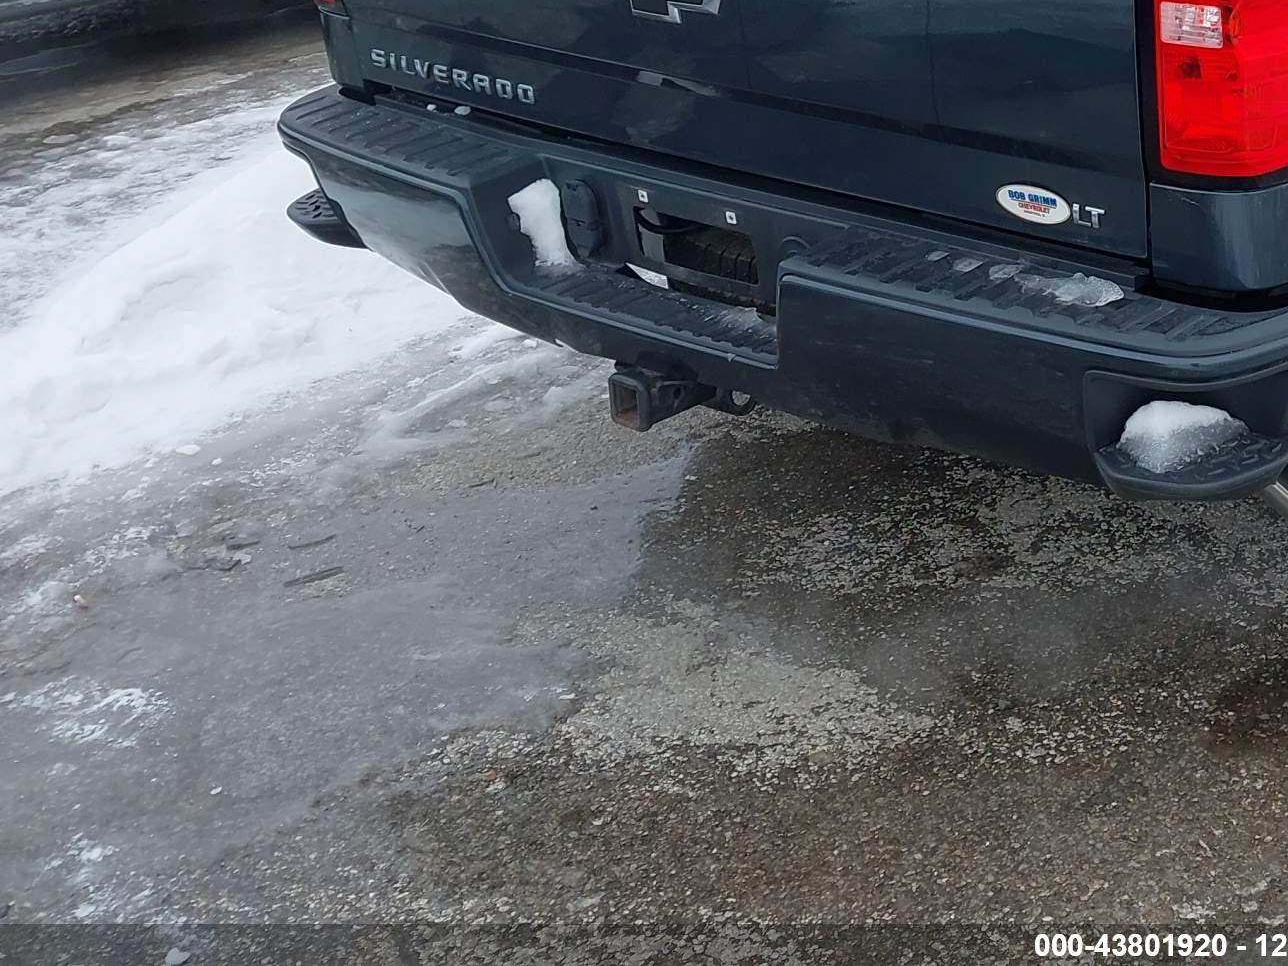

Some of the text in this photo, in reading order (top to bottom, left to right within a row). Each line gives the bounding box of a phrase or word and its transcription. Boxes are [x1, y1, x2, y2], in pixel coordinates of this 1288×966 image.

[370, 48, 536, 104] SILVERADO
[1008, 189, 1057, 206] BOB GRIMM
[1072, 202, 1106, 229] LT
